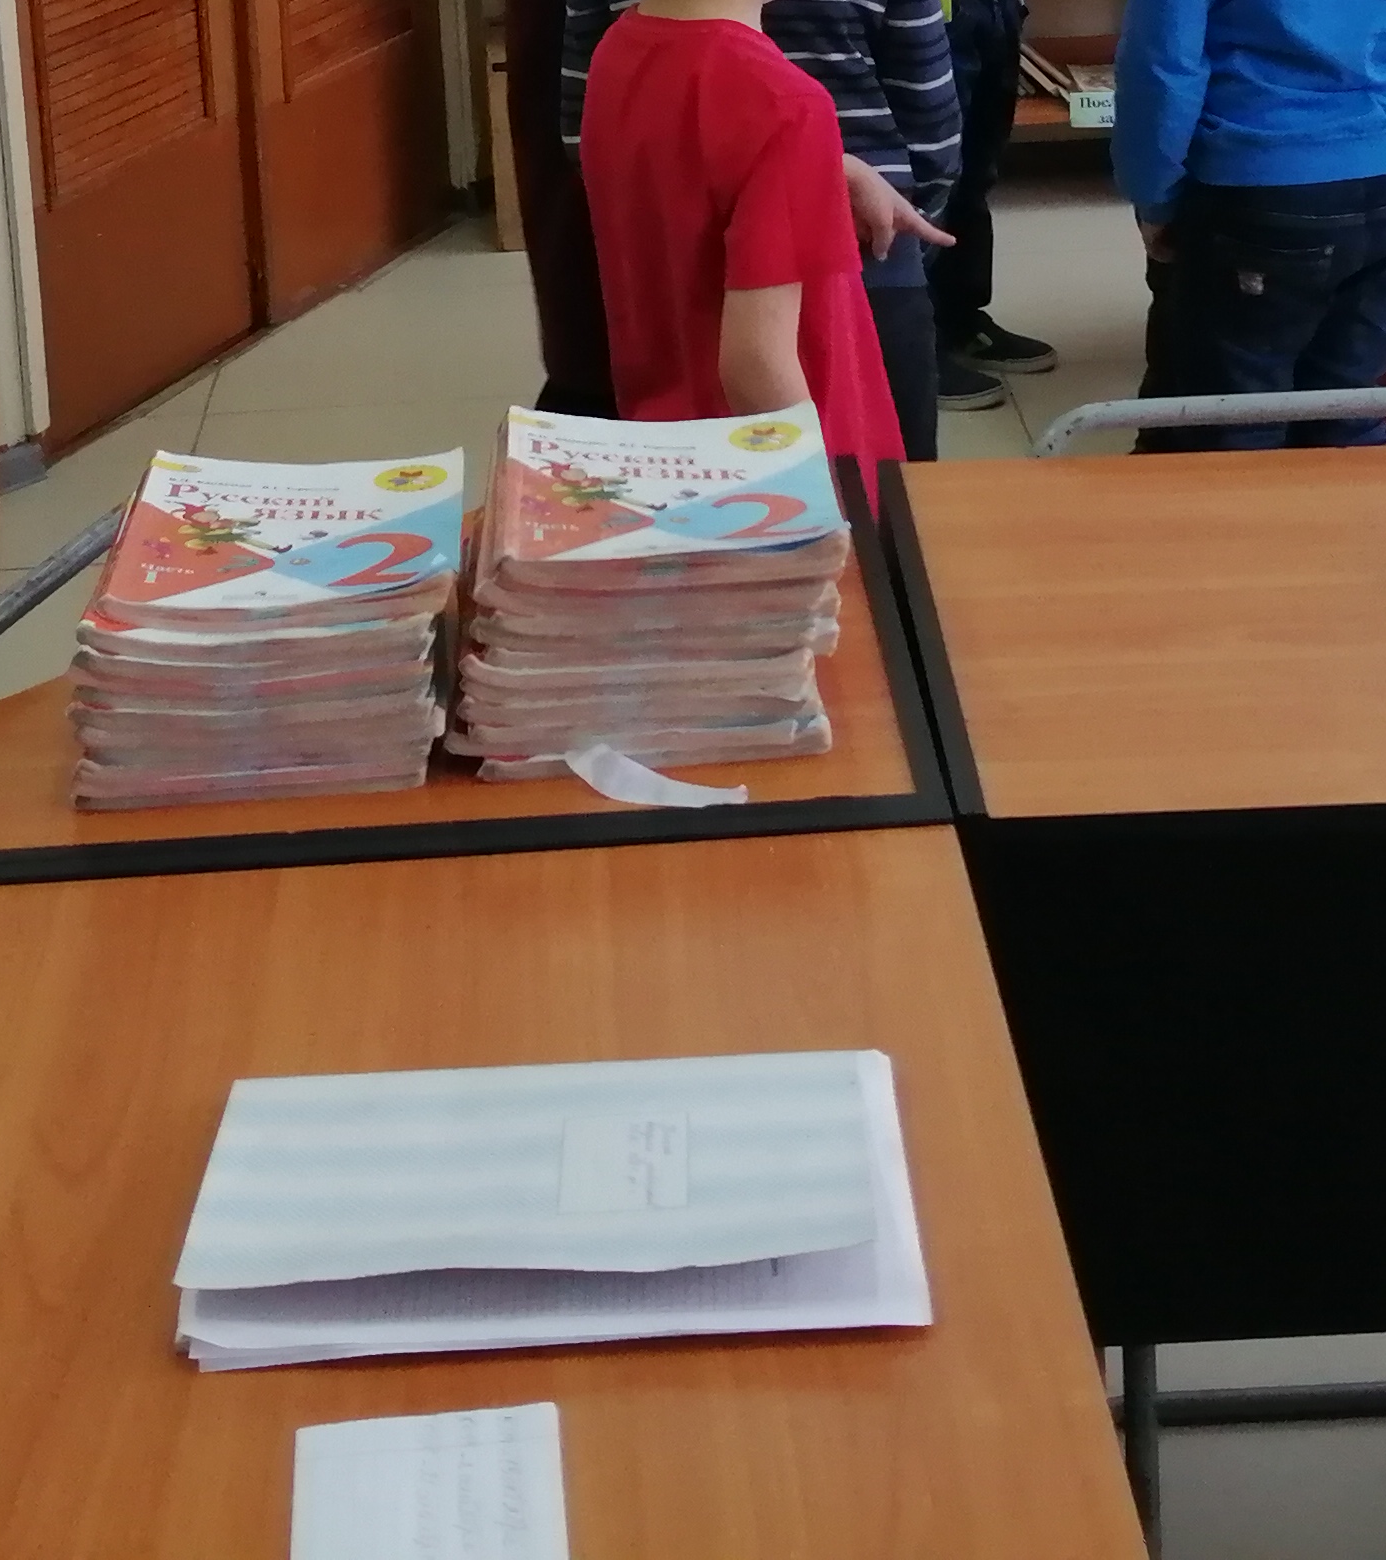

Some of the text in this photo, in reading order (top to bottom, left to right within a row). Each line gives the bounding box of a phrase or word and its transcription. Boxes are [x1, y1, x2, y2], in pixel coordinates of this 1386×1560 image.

[529, 438, 696, 466] Русский
[618, 467, 747, 481] язык
[165, 482, 335, 507] Русский
[254, 508, 384, 522] язык
[711, 493, 824, 540] 2
[327, 532, 434, 587] 2
